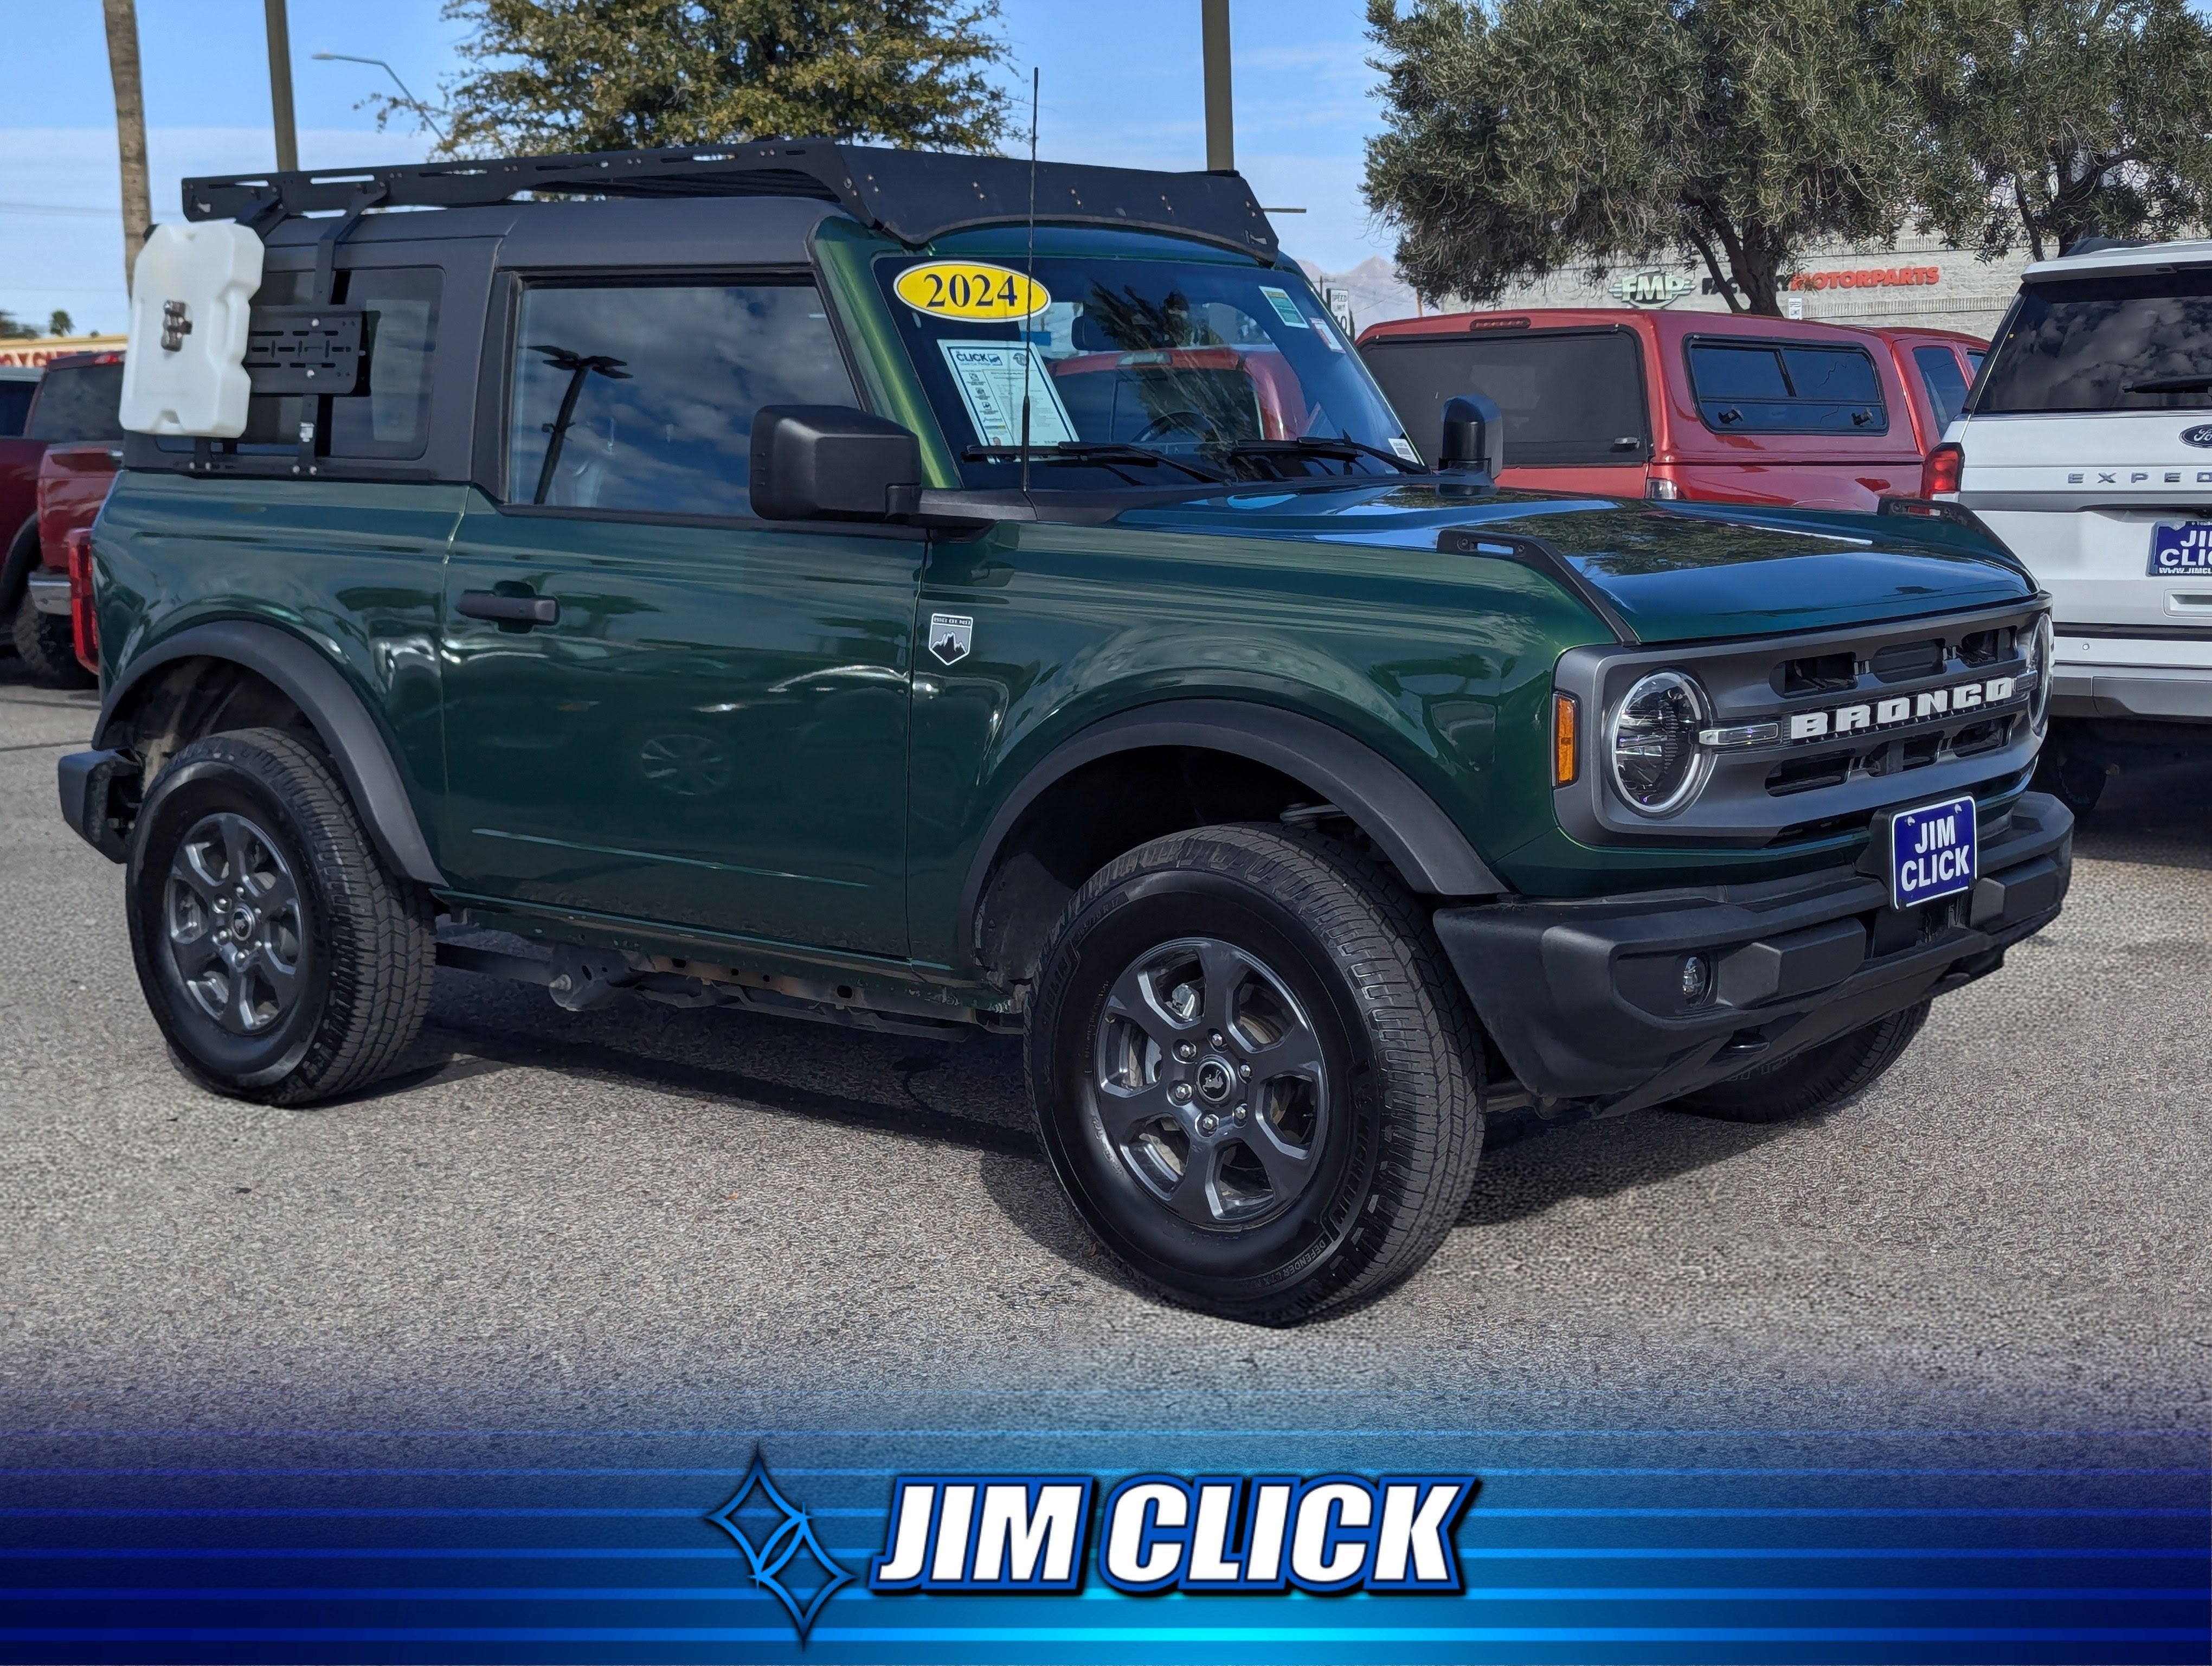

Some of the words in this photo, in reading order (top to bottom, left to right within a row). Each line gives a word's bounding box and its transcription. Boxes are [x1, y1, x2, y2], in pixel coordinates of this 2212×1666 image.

[924, 273, 1018, 308] 2024
[1622, 275, 1683, 302] FMP
[1790, 267, 1939, 292] MOTORPARTS
[956, 353, 988, 362] CLICK
[2180, 530, 2212, 547] JI
[2160, 548, 2212, 566] CLI
[1791, 677, 2012, 739] BRONCO
[1914, 815, 1956, 854] JIM
[1901, 844, 1970, 892] CLICK
[1282, 1239, 1327, 1277] DEFENDER
